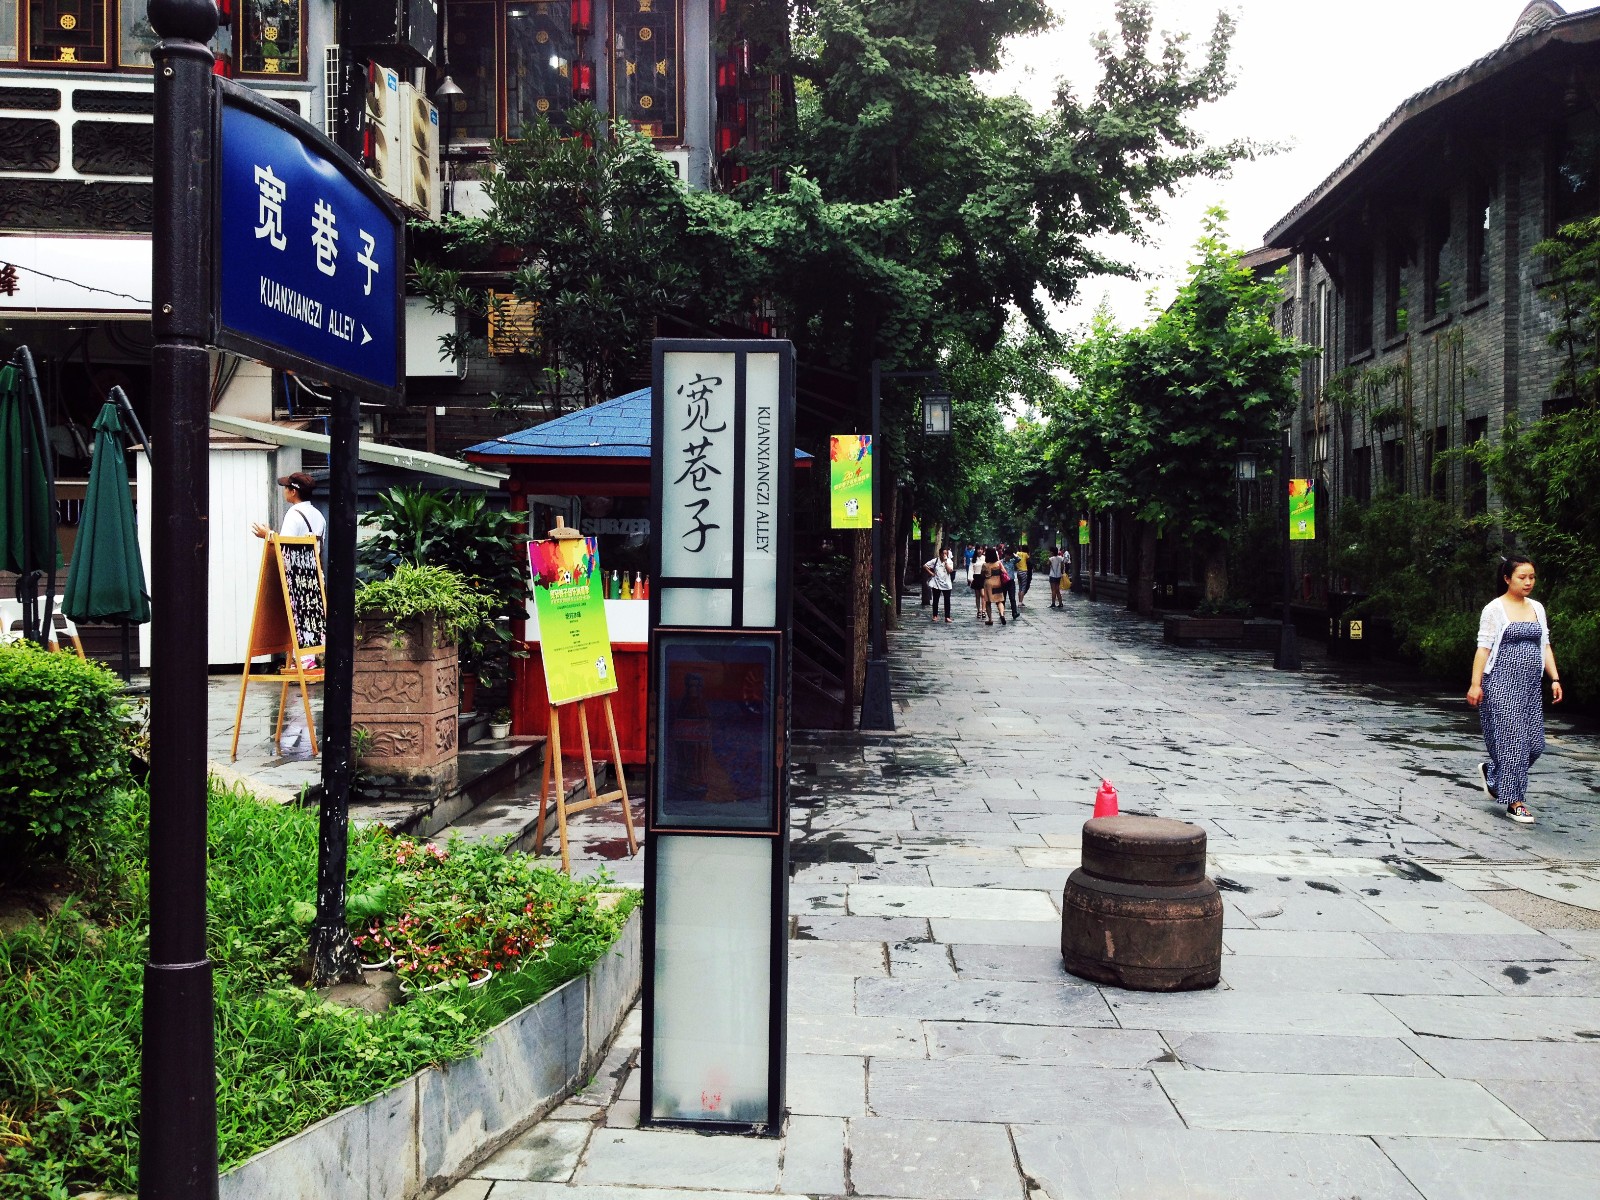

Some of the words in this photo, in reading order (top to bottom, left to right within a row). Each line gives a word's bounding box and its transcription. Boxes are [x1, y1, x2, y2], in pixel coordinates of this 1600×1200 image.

[254, 164, 379, 296] 宽巷子
[260, 275, 322, 329] KUANXIANGZI
[328, 308, 355, 342] ALLEY
[673, 373, 727, 553] 宽巷子
[756, 406, 771, 506] KUANXIANGZI
[756, 509, 769, 553] ALLEY
